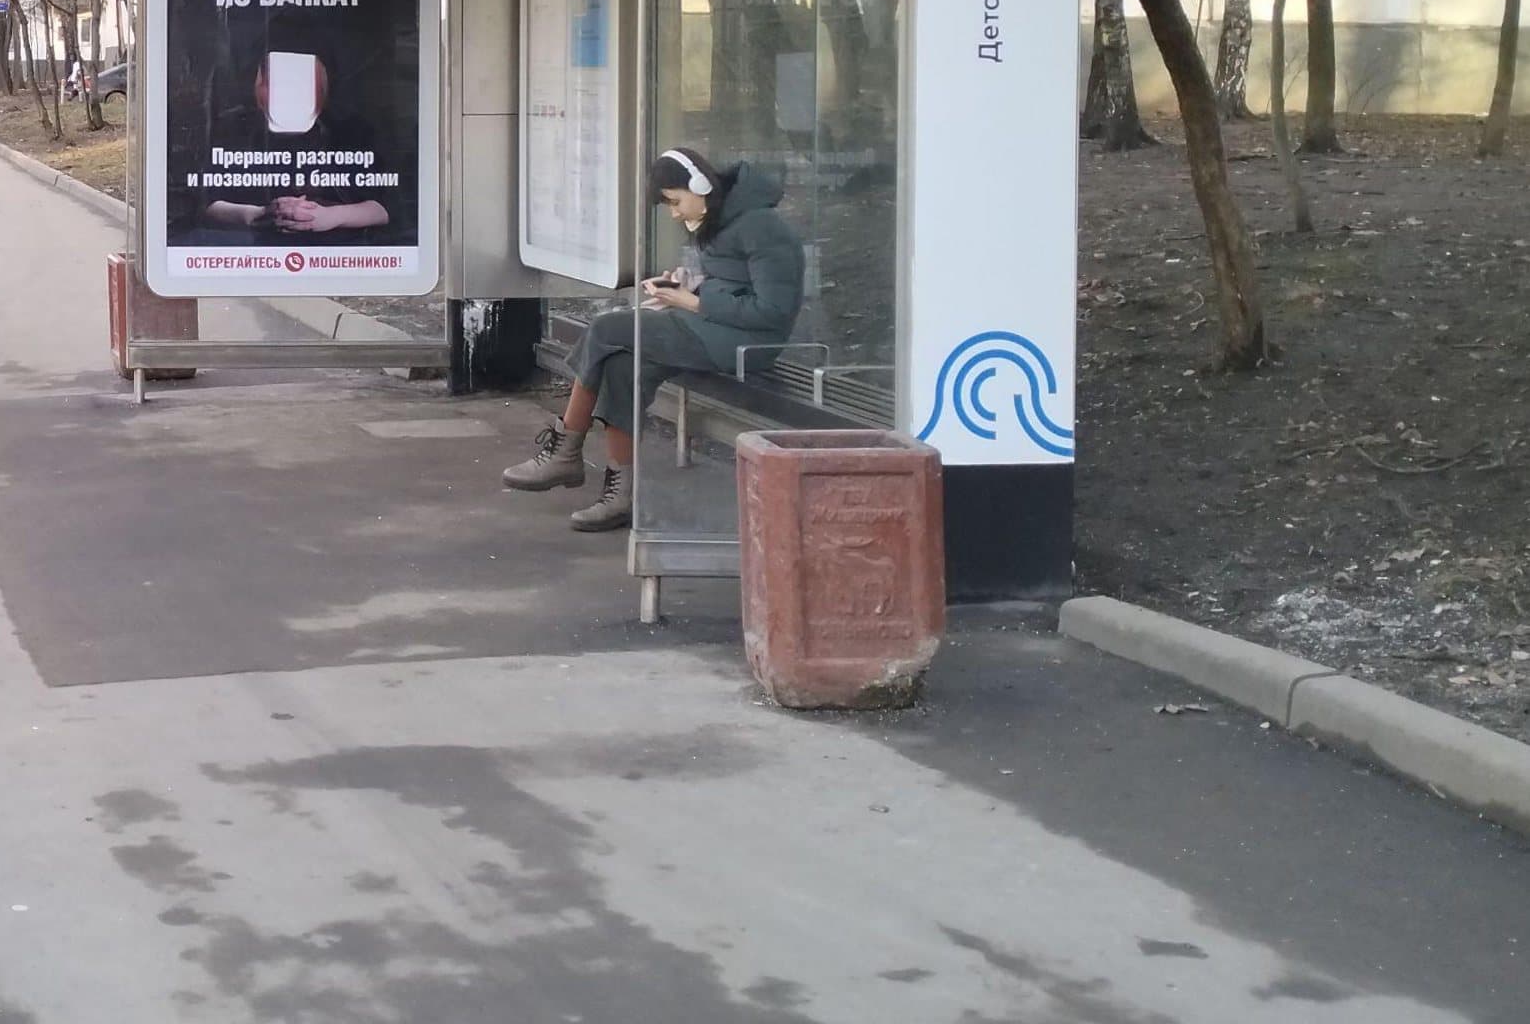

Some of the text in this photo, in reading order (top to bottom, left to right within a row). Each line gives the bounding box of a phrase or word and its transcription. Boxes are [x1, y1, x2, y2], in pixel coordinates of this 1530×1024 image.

[211, 147, 375, 169] Прервите разговор
[187, 169, 399, 187] и позвоните в банк сами
[185, 254, 402, 269] ОСТЕРЕГАЙТЕСЬ МОШЕННИКОВ!
